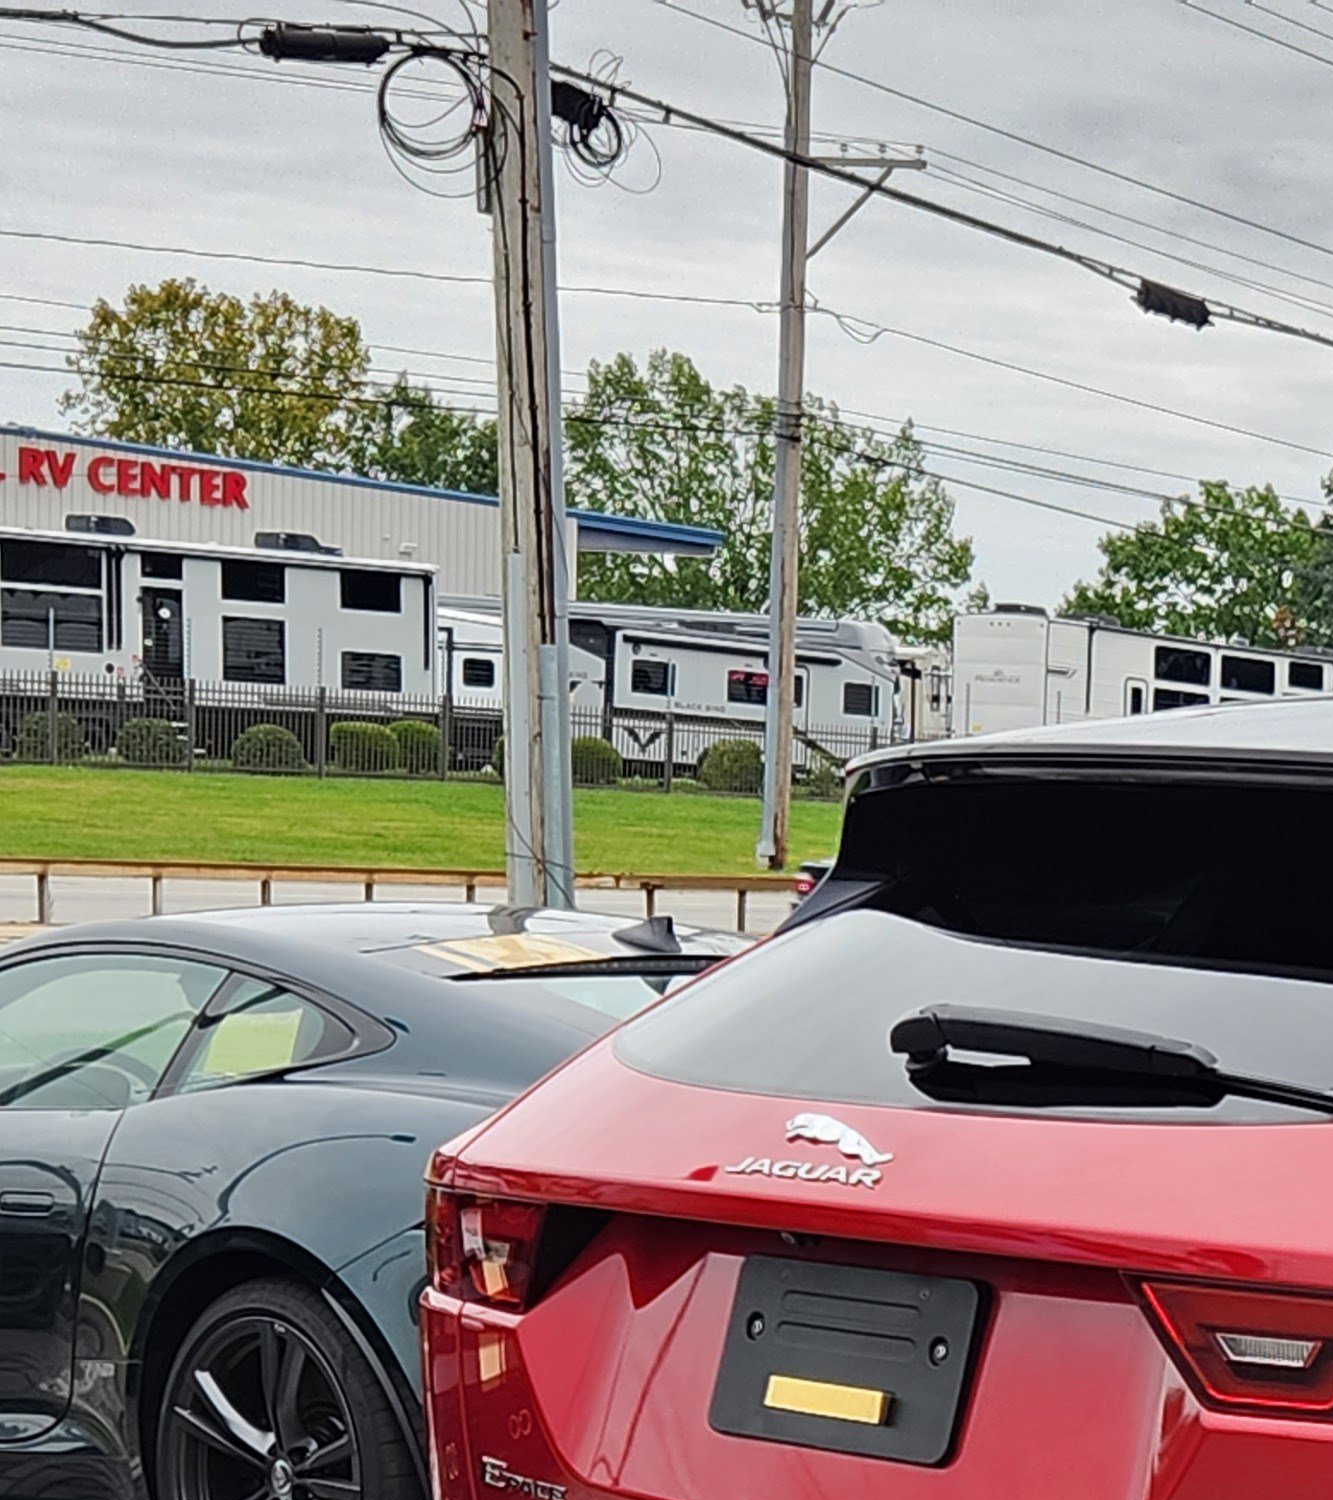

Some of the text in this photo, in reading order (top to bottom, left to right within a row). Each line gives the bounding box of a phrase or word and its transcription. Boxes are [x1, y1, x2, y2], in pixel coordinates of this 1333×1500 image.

[18, 446, 250, 510] RV CENTER
[725, 1157, 882, 1189] JAGUAR
